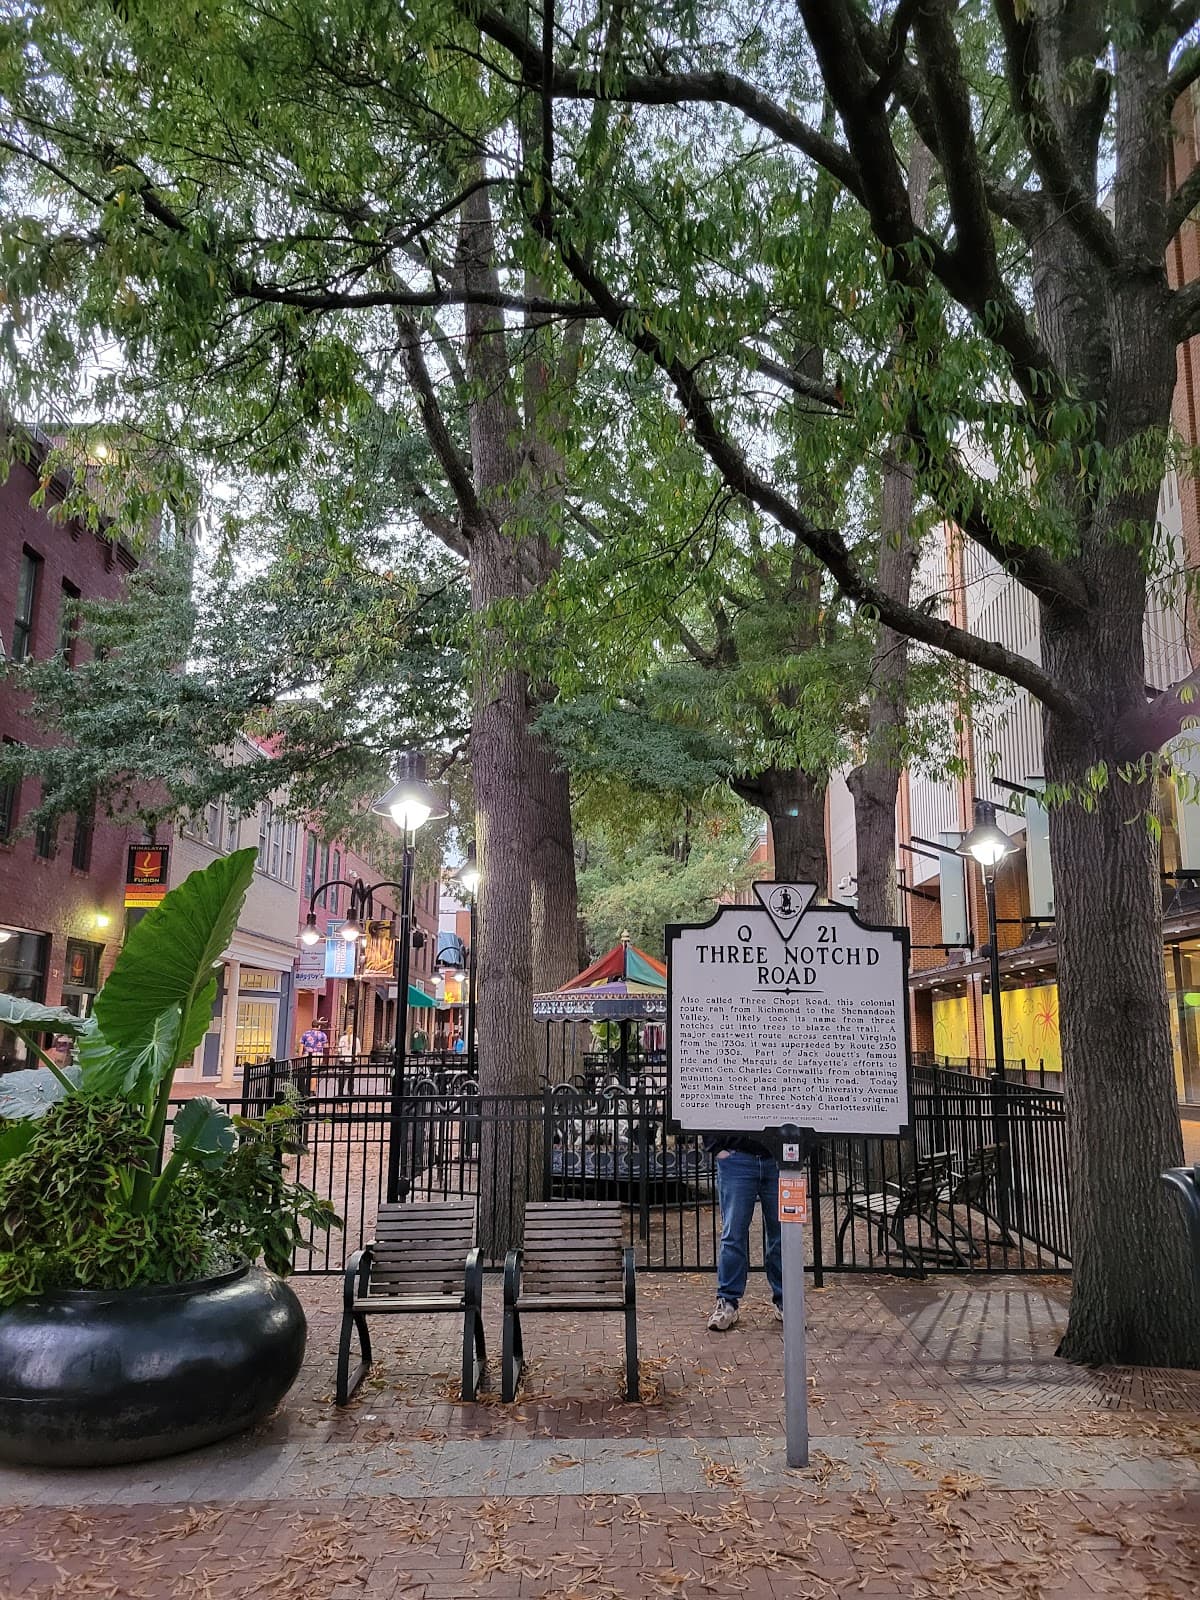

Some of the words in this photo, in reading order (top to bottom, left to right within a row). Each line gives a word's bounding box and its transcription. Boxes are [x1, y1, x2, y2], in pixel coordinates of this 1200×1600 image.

[737, 924, 752, 942] Q
[817, 925, 837, 943] 21
[696, 945, 768, 964] THREE
[784, 946, 880, 966] NOTCH'D
[758, 966, 817, 985] ROAD
[773, 997, 799, 1006] Chopt
[680, 1013, 709, 1021] Valley.
[736, 1014, 761, 1022] likely
[679, 1030, 705, 1038] major
[859, 1033, 896, 1042] Virginia
[781, 1041, 830, 1049] superseded
[834, 1042, 845, 1050] by
[742, 1058, 777, 1066] Marquis
[798, 1059, 847, 1067] Lafayette's
[680, 1065, 712, 1073] prevent
[854, 1069, 897, 1077] obtaining
[753, 1075, 776, 1083] place
[783, 1076, 806, 1084] along
[869, 1078, 897, 1086] Today
[781, 1085, 800, 1093] part
[818, 1085, 863, 1094] University
[680, 1092, 733, 1100] approximate
[862, 1095, 898, 1103] original
[715, 1101, 750, 1109] through
[756, 1102, 812, 1111] present-day
[818, 1103, 887, 1111] Charlottesville.
